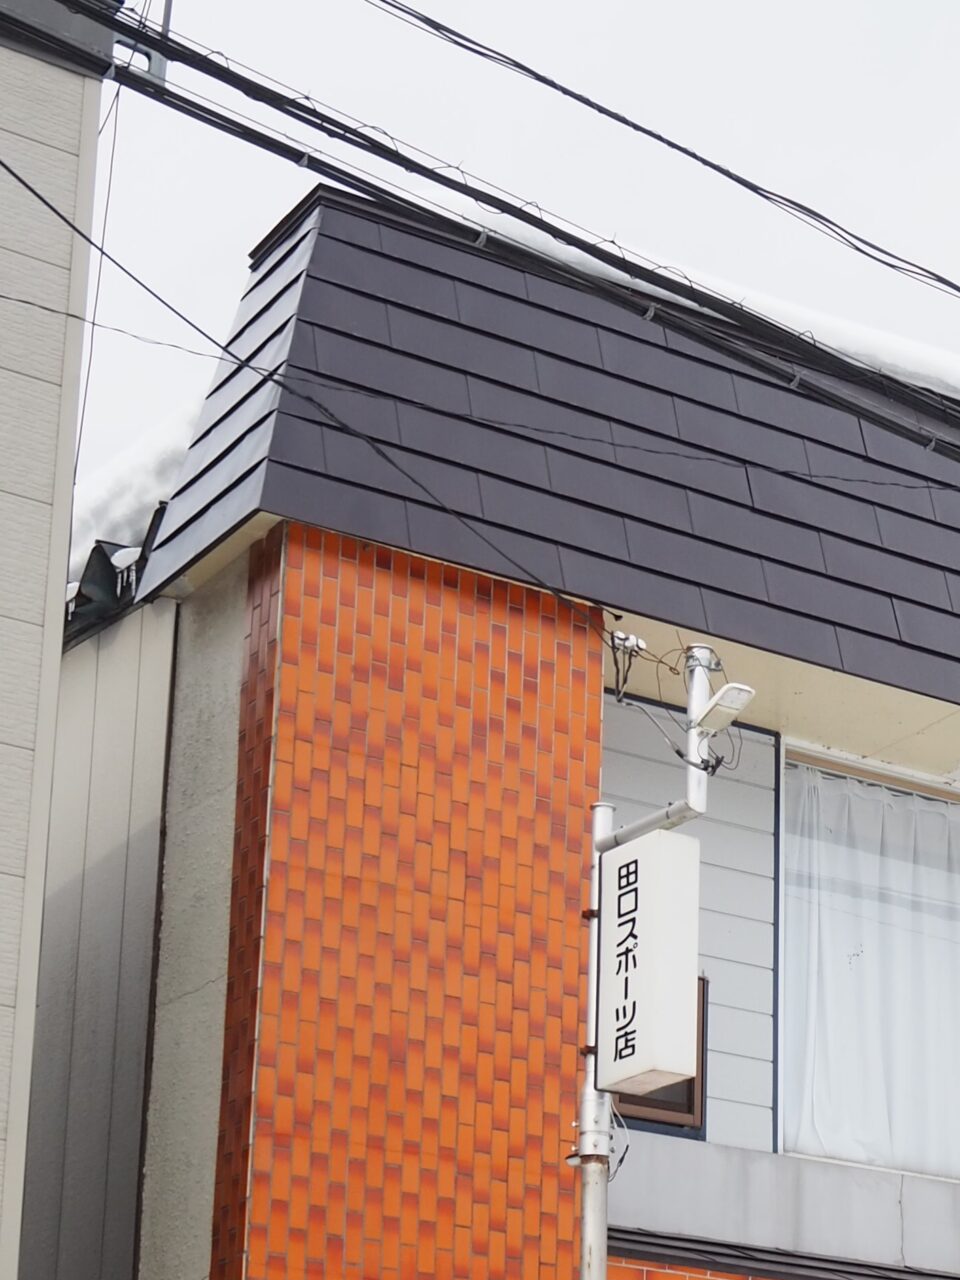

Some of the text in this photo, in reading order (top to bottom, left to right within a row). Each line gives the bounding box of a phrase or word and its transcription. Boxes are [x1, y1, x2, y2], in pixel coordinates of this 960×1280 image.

[614, 859, 638, 1062] 田口スポーツ店
